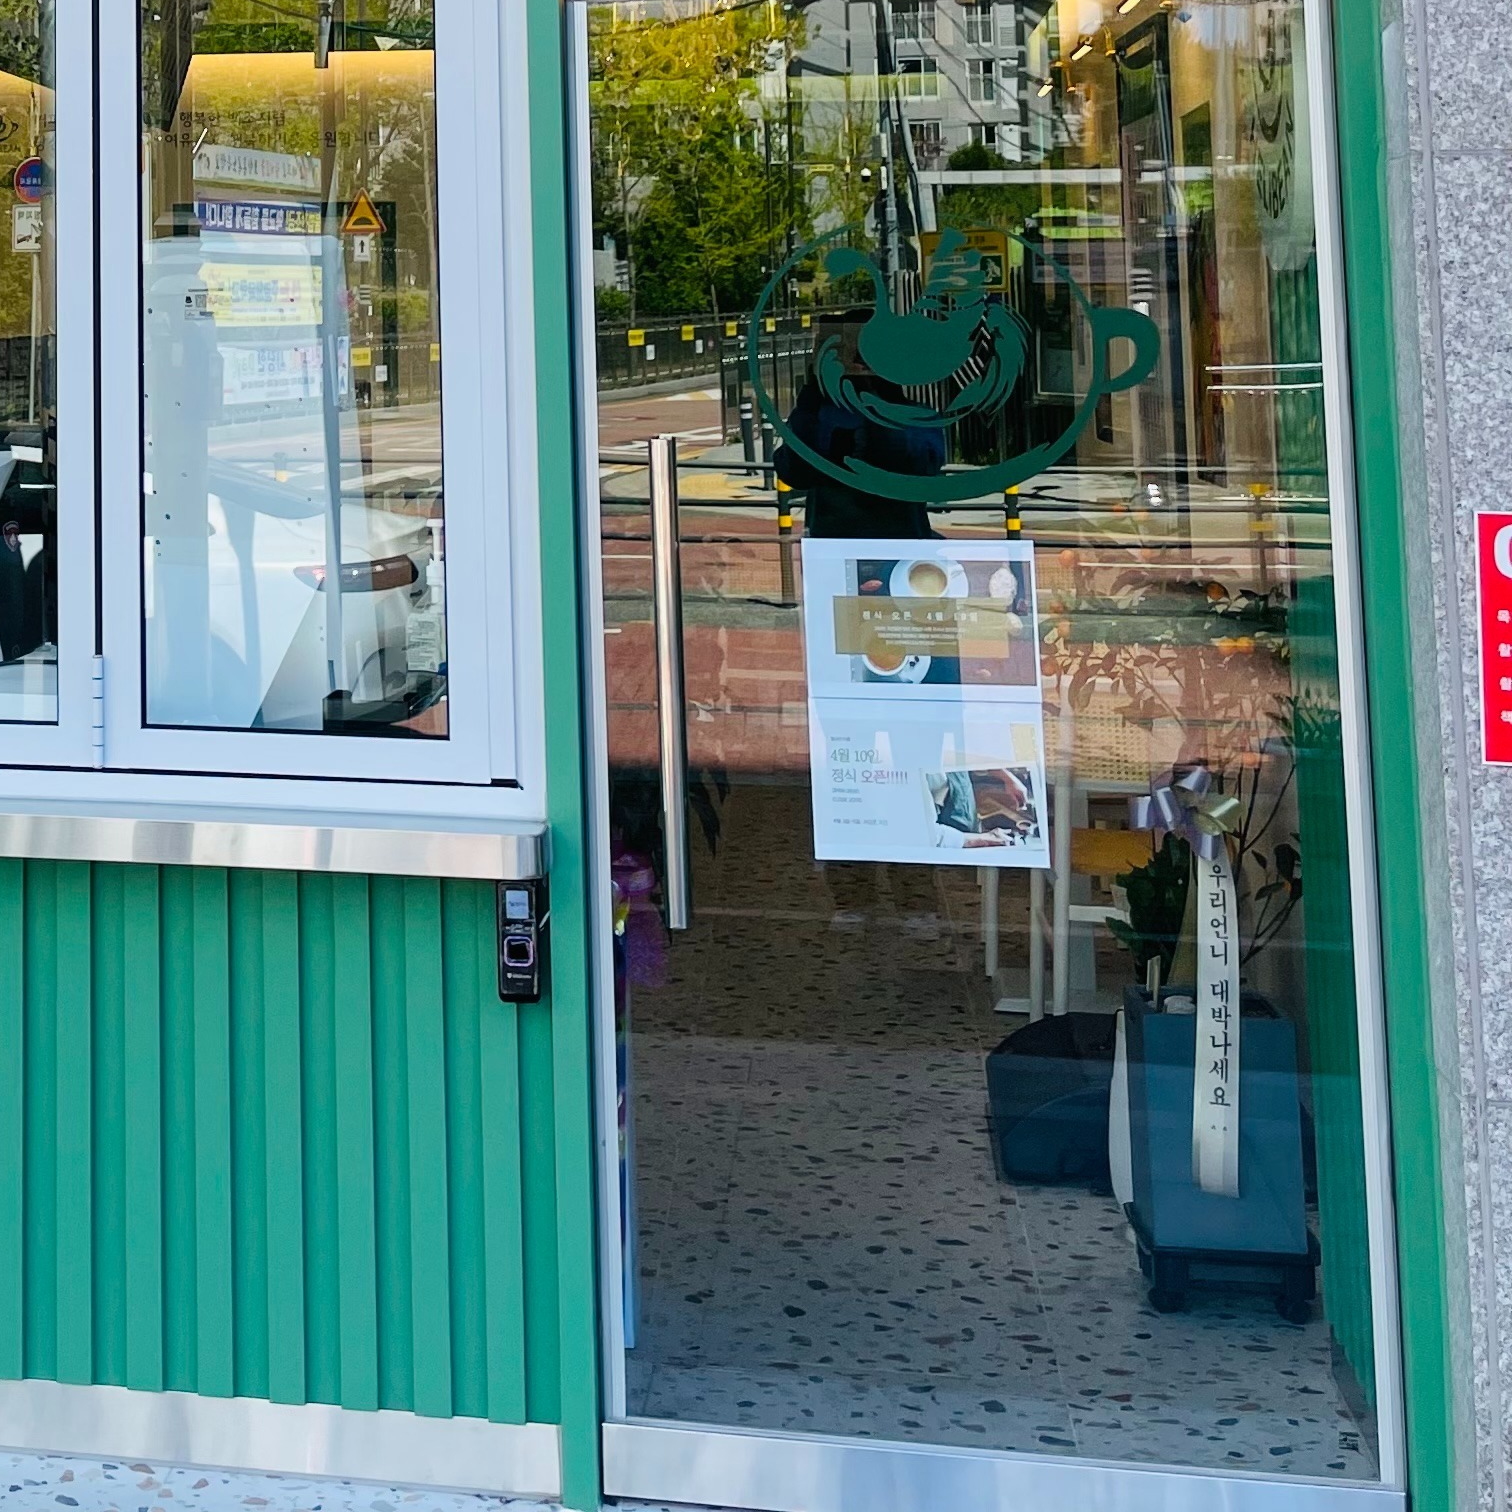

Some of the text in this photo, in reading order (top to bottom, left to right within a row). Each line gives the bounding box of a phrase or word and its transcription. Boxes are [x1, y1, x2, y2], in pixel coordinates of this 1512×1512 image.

[830, 748, 850, 764] 4월
[831, 767, 857, 784] 정식
[1206, 863, 1229, 967] 우리언니
[1208, 978, 1232, 1108] 대박나세요
